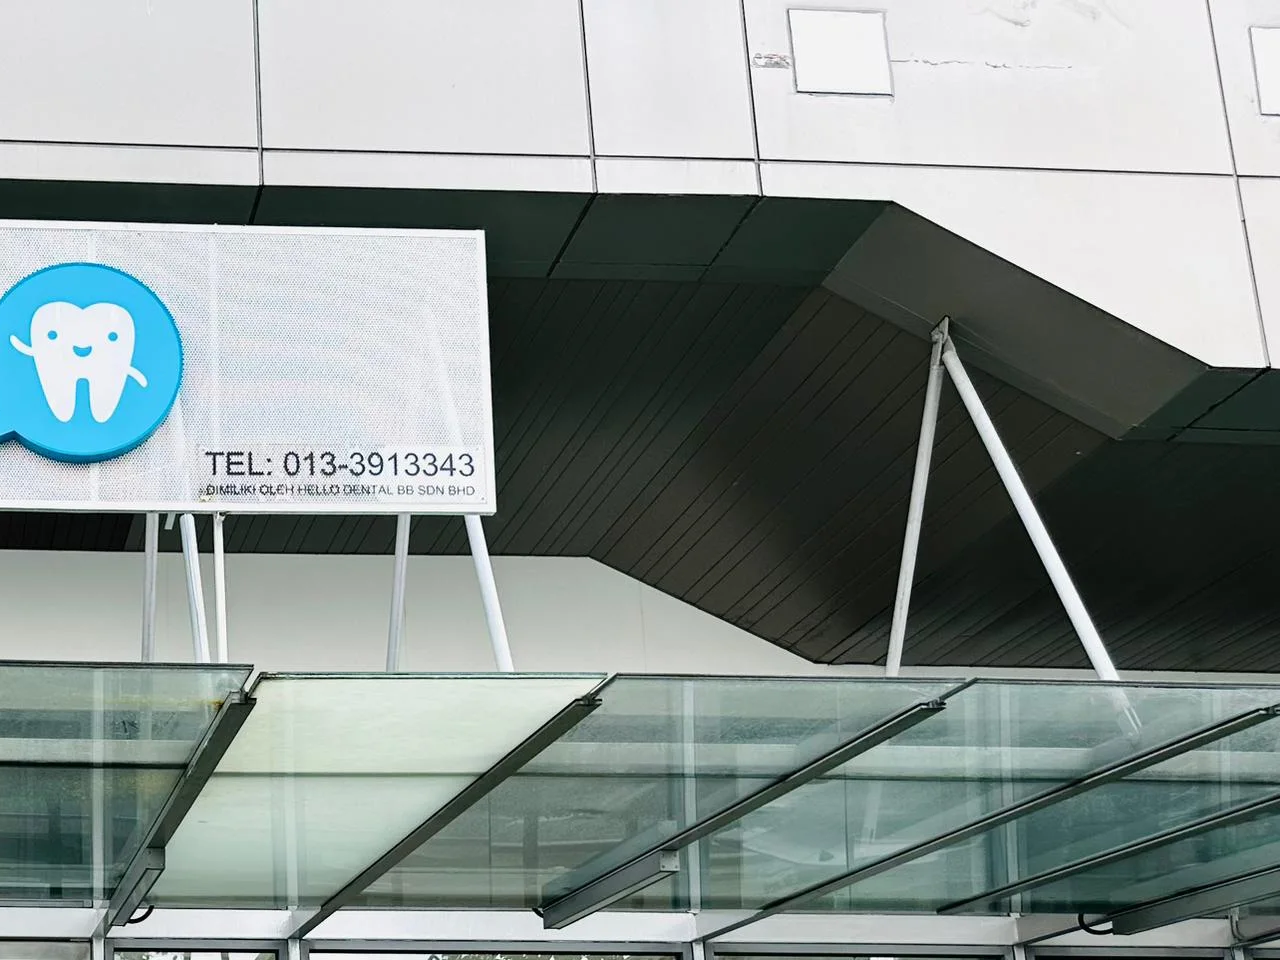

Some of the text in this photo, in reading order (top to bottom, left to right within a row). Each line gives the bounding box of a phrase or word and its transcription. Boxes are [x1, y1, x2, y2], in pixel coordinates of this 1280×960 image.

[205, 450, 476, 477] TEL: 013-3913343
[259, 484, 295, 496] OLEH
[298, 484, 340, 496] HELLO
[343, 484, 394, 496] DENTAL
[397, 485, 415, 496] BB
[417, 485, 445, 496] SDN
[448, 485, 476, 496] BHD
